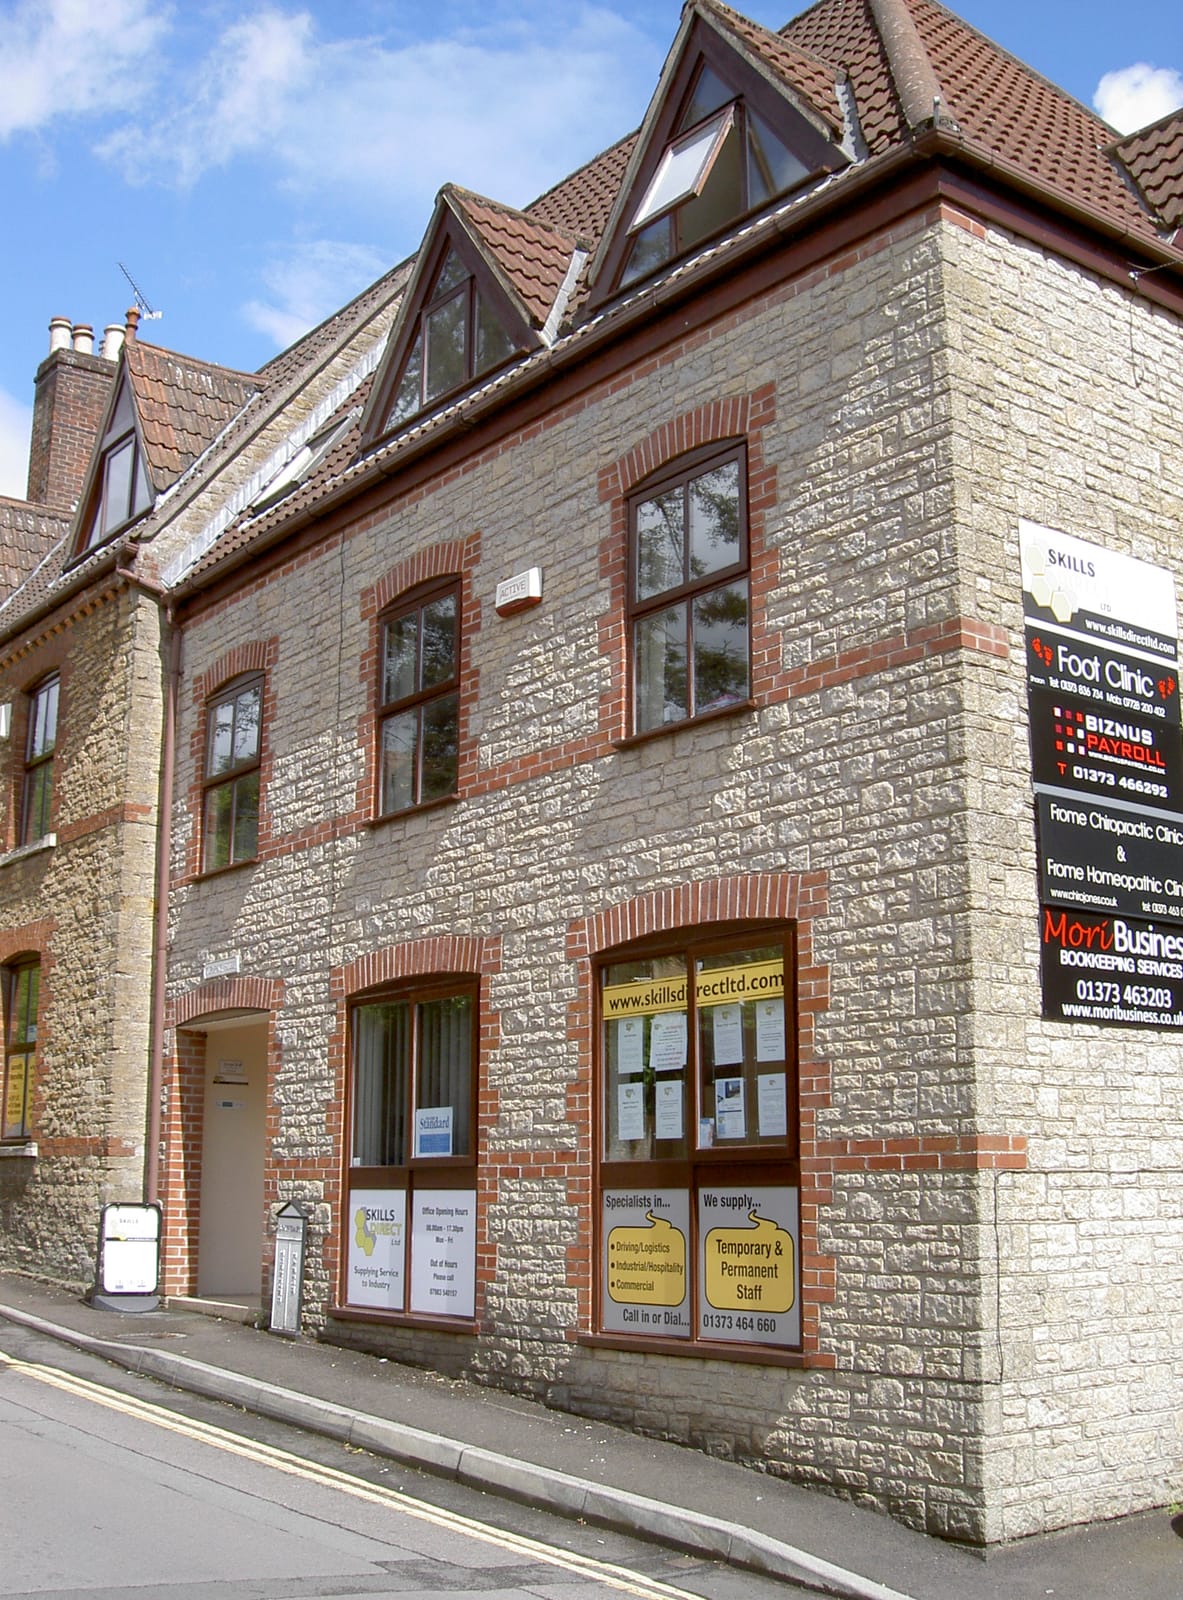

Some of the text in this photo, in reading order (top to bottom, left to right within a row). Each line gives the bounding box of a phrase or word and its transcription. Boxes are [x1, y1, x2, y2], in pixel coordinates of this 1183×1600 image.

[1048, 549, 1096, 578] SKILLS
[1085, 619, 1176, 655] www.skillsdirectltd.com
[1057, 644, 1155, 698] Foot Clinic
[1085, 714, 1153, 746] BIZNUS
[1086, 733, 1166, 767] PAYROLL
[1056, 761, 1168, 798] T 01373 466292
[1050, 803, 1087, 826] Frome
[1089, 811, 1154, 840] Chiropractic
[1116, 845, 1127, 863] &
[1046, 858, 1085, 881] Frome
[1086, 864, 1163, 893] Homeopathic
[1043, 909, 1114, 951] Mori
[1059, 949, 1183, 980] BOOKKEEPING SERVICES
[1076, 979, 1173, 1009] 01373 463203
[605, 1194, 671, 1210] Specialists in...
[703, 1193, 762, 1210] We supply...
[365, 1208, 395, 1222] SKILLS
[369, 1222, 402, 1237] DIRECT
[616, 1241, 671, 1255] Driving/Logistics
[716, 1239, 784, 1259] Temporary &
[353, 1265, 379, 1278] Supplying
[616, 1260, 684, 1276] Industrial/Hospitality
[721, 1261, 779, 1279] Permanent
[361, 1279, 391, 1292] to Industry
[616, 1279, 655, 1291] Commercial
[736, 1283, 763, 1301] Staff
[622, 1308, 640, 1323] Call
[641, 1309, 650, 1323] in
[651, 1312, 662, 1324] or
[703, 1314, 777, 1333] 01373 464 660
